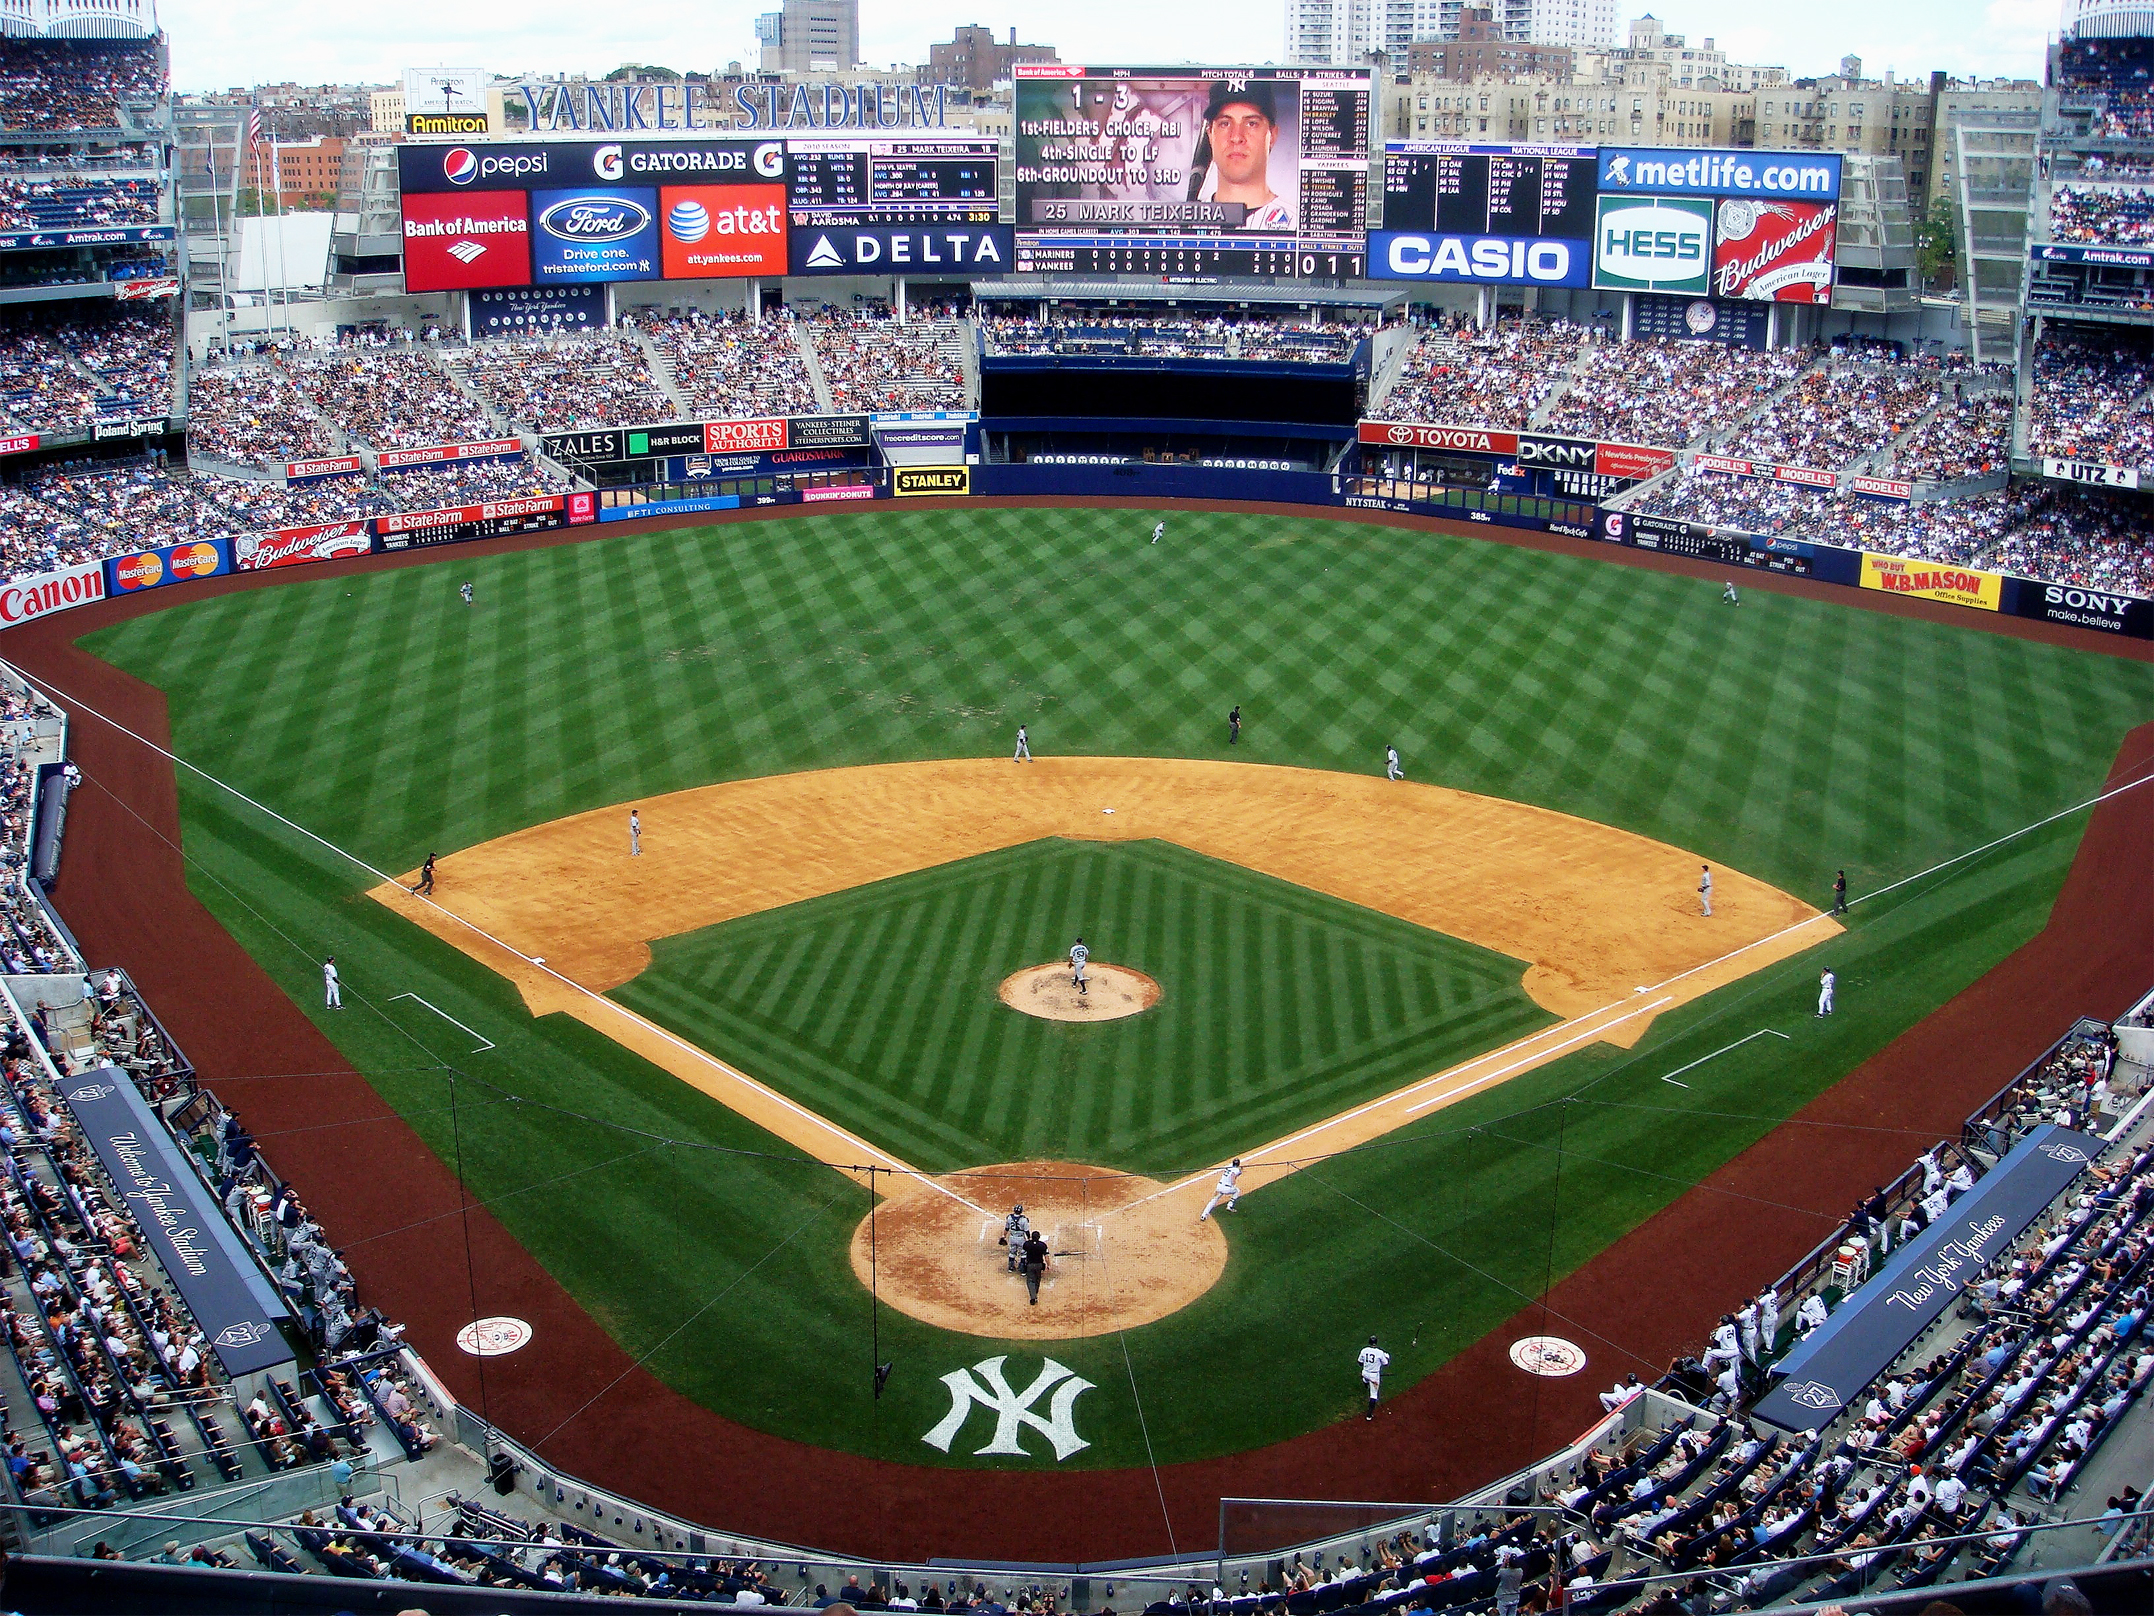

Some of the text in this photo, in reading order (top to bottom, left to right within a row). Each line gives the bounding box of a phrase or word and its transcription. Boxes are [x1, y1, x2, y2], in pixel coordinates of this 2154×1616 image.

[430, 76, 464, 86] Armitron
[1040, 68, 1066, 76] America
[1276, 70, 1309, 79] BALLS: 2
[1316, 70, 1357, 79] STRIKES: 4
[1072, 84, 1129, 109] 1 3
[518, 83, 948, 132] YANKEE STADIUM
[412, 114, 487, 134] Armitron
[1020, 120, 1182, 139] 1st-FIELDER'S CHOICE, RBI
[897, 146, 908, 154] 25
[912, 146, 936, 154] MARK
[936, 146, 970, 154] TEIXEIRA
[1041, 146, 1160, 162] 4th-SINGLE TO LF
[1404, 144, 1441, 152] AMERICAN
[1512, 146, 1578, 156] NATIONAL LEAGUE
[480, 150, 548, 178] pepsi
[630, 151, 747, 172] GATORADE
[1016, 168, 1182, 184] 6th-GROUNDOUT TO 3RD
[1635, 156, 1830, 192] metlife.com
[562, 205, 624, 234] Ford
[716, 204, 781, 235] at&t
[812, 212, 990, 226] AARDSMA 3:30
[1045, 204, 1226, 221] 25 MARK TEIXEIRA
[404, 216, 527, 238] Bank of America
[66, 232, 126, 244] Amtrak.com
[1606, 229, 1700, 260] HESS
[563, 248, 630, 260] Drive one.
[687, 252, 763, 265] att.yankees.com
[856, 235, 1001, 264] DELTA
[1035, 250, 1291, 262] MARINERS 0 0 0 0 0 0 0 2 2 5 0
[1713, 203, 1836, 297] Budweiser
[2081, 250, 2150, 266] Amtrak.com
[543, 260, 637, 274] tristateford.com
[1035, 262, 1074, 271] YANKEES
[1302, 254, 1360, 276] 0 1 1
[1388, 236, 1570, 282] CASIO
[120, 280, 170, 300] Budweiser
[1759, 268, 1828, 294] American Lager
[95, 420, 165, 442] Poland Spring
[650, 434, 701, 446] H&R BLOCK
[709, 422, 783, 441] SPORTS
[802, 427, 854, 436] COLLECTIBLES
[884, 432, 960, 442] freecreditscore.com
[1416, 428, 1492, 450] TOYOTA
[550, 434, 614, 457] ZALES
[794, 436, 862, 445] STEINERSPORTS.COM
[771, 450, 844, 464] GUARDSMARK
[1518, 442, 1595, 466] DKNY
[1496, 464, 1526, 478] FedEx
[1698, 456, 1746, 472] MODELL'S
[902, 474, 962, 488] STANLEY
[1554, 470, 1616, 488] SHARPER
[1780, 468, 1832, 484] MODELL'S
[2070, 464, 2106, 483] UTZ
[810, 490, 872, 500] DUNKIN' DONUTS
[1854, 478, 1910, 496] MODELL'S
[655, 503, 711, 514] CONSULTING
[1345, 498, 1362, 507] NYY
[1362, 498, 1386, 509] STEAK
[1549, 522, 1563, 532] Hard
[1563, 525, 1576, 536] Rock
[1642, 520, 1677, 530] GATORADE
[249, 522, 348, 570] Budweiser
[1776, 541, 1798, 552] pepsi
[172, 552, 219, 570] MasterCard
[1870, 560, 1906, 572] WHO BUT
[118, 562, 164, 582] MasterCard
[1880, 571, 1982, 595] W.B.MASON
[0, 566, 103, 622] Canon
[1934, 590, 1988, 606] Office Supplies
[2044, 586, 2132, 616] SONY
[2046, 608, 2122, 630] make.believe
[108, 1132, 147, 1178] Welcome
[126, 1182, 187, 1228] Yankee
[166, 1227, 209, 1276] Stadium
[1885, 1214, 2006, 1311] New York Yankees
[1364, 1353, 1376, 1364] 13
[921, 1355, 1098, 1462] NY
